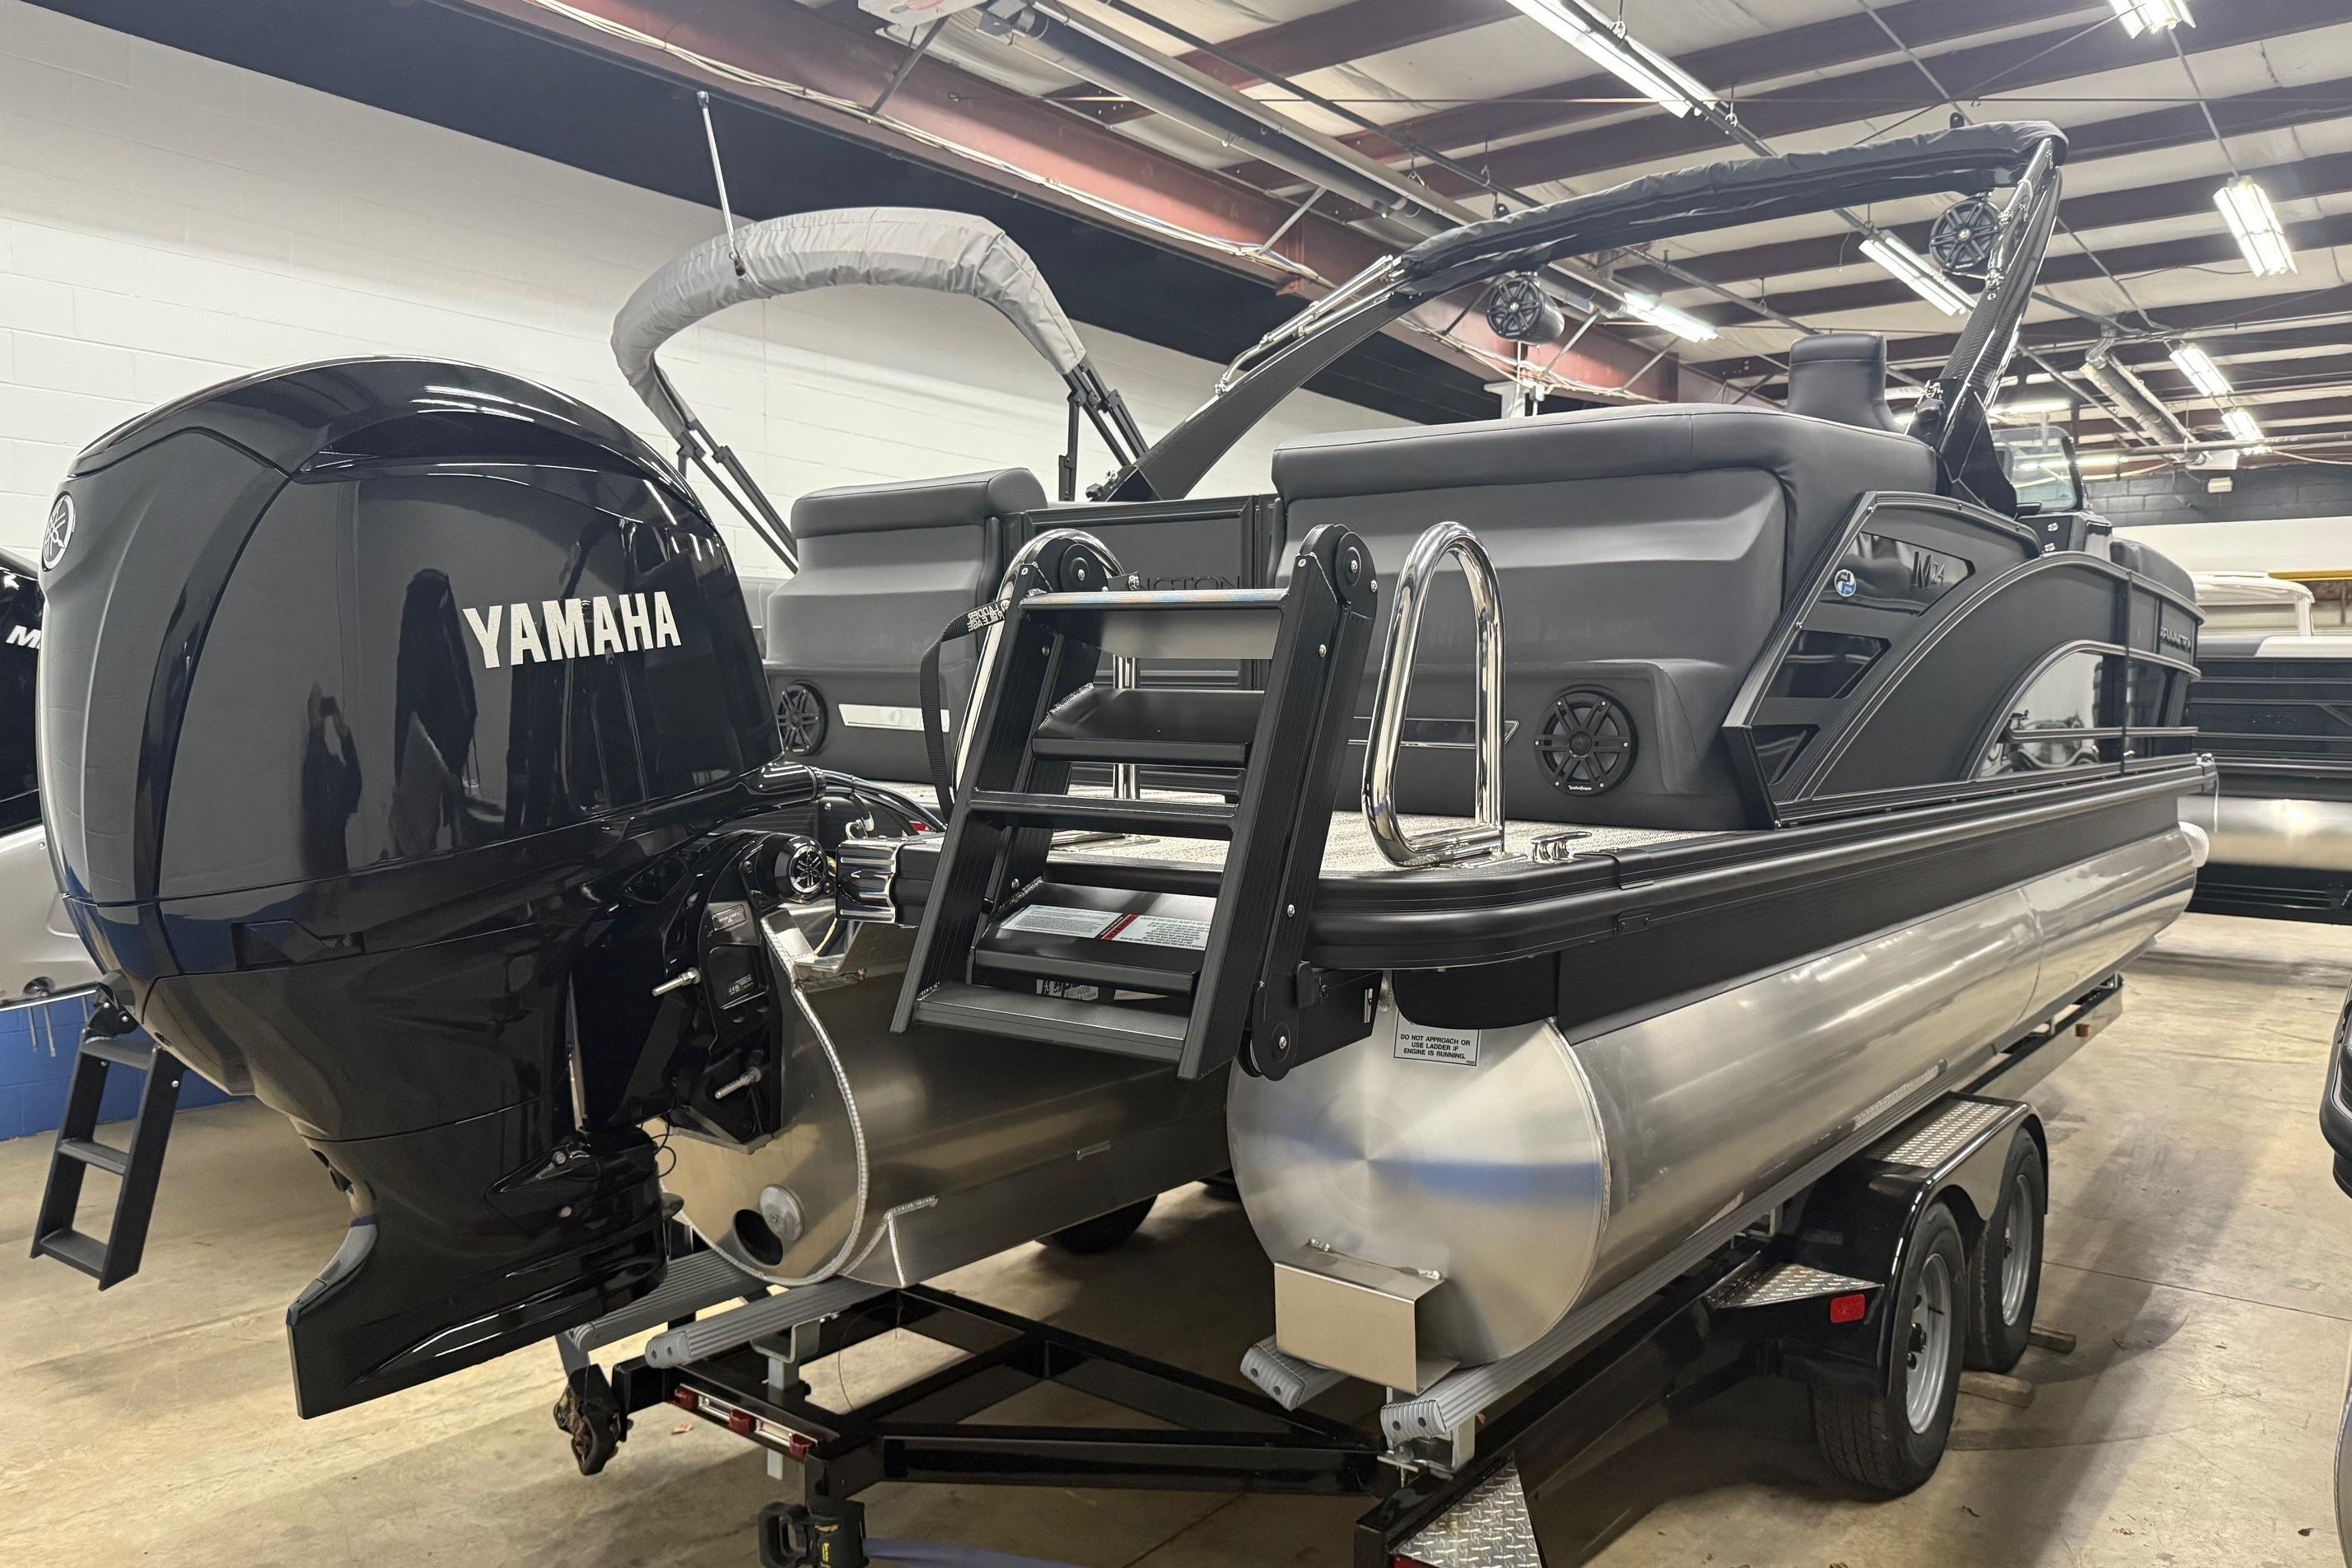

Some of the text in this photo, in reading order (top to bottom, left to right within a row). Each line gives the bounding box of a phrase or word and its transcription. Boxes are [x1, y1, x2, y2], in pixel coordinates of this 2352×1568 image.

[462, 590, 682, 669] YAMAHA
[1426, 1036, 1459, 1045] APPROACH
[1426, 1043, 1450, 1052] LADDER
[1403, 1048, 1426, 1056] ENGINE
[1436, 1051, 1466, 1059] RUNNING.
